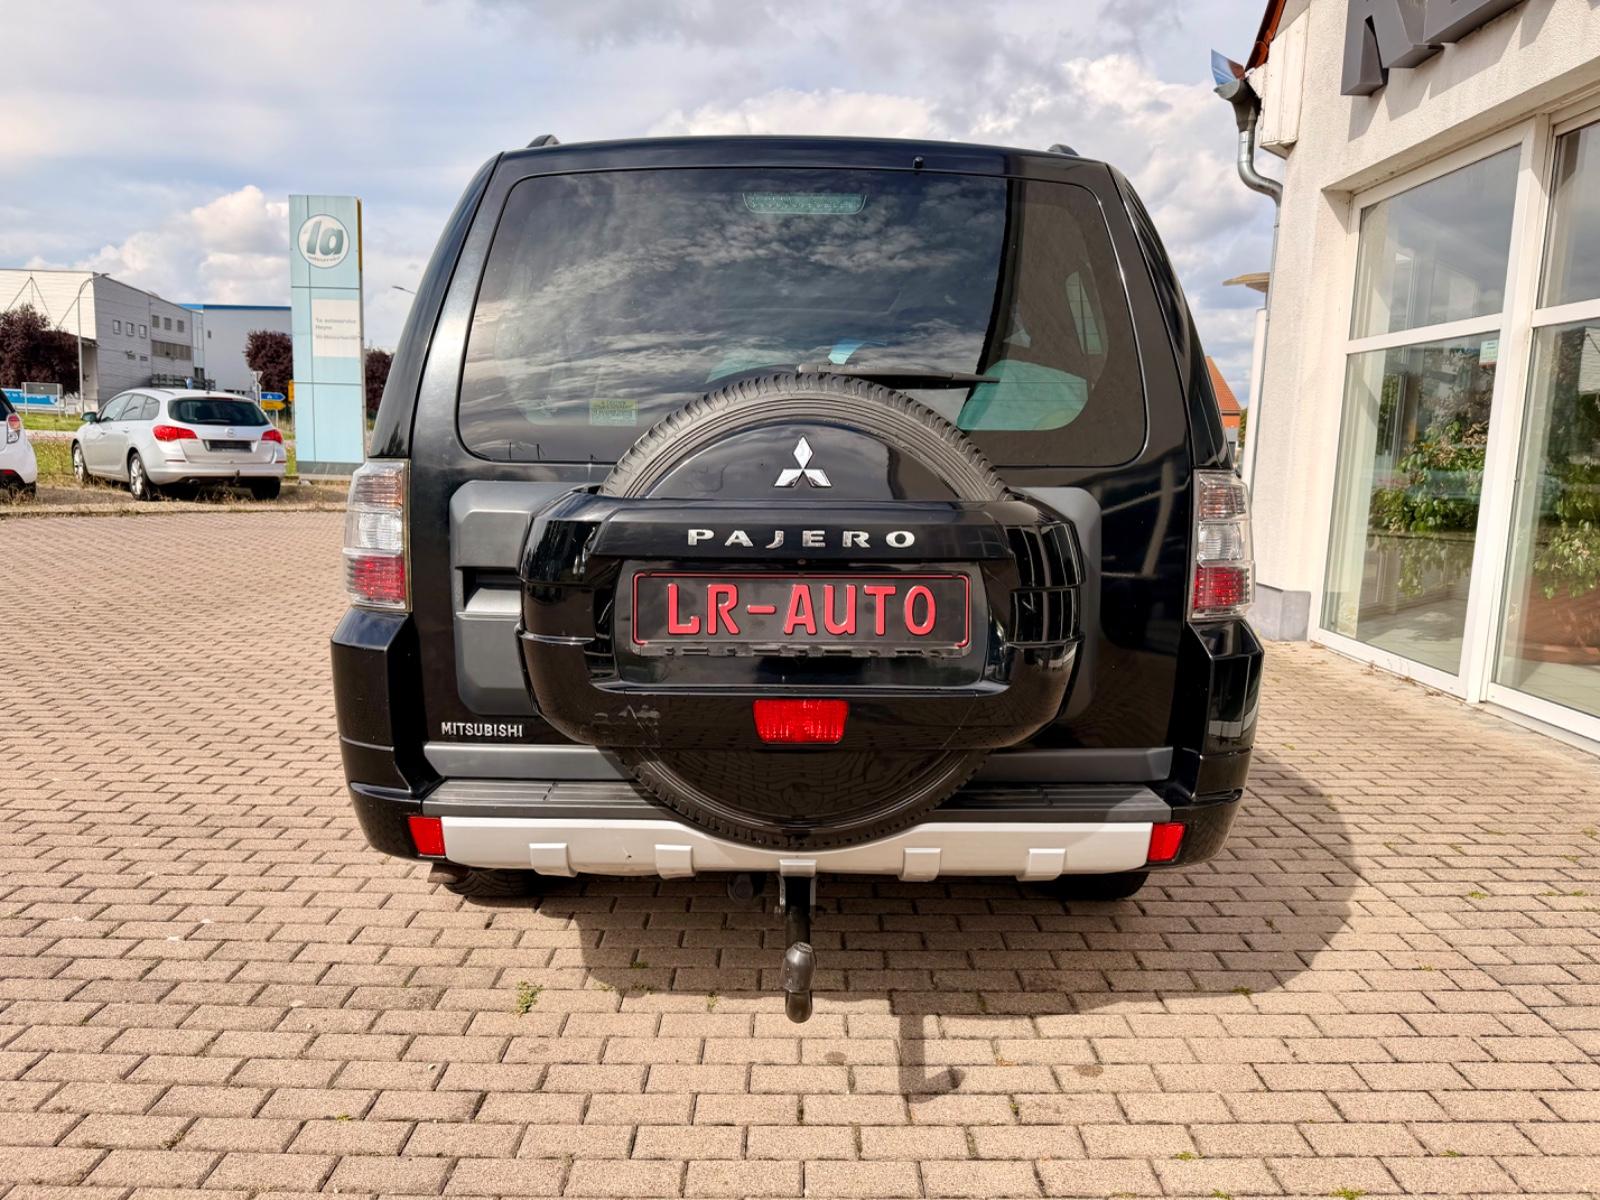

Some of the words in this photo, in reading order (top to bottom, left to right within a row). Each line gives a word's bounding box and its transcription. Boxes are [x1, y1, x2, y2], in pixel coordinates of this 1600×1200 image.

[687, 528, 916, 549] PAJERO
[667, 583, 937, 636] LR-AUTO
[441, 721, 523, 738] MITSUBISHI
